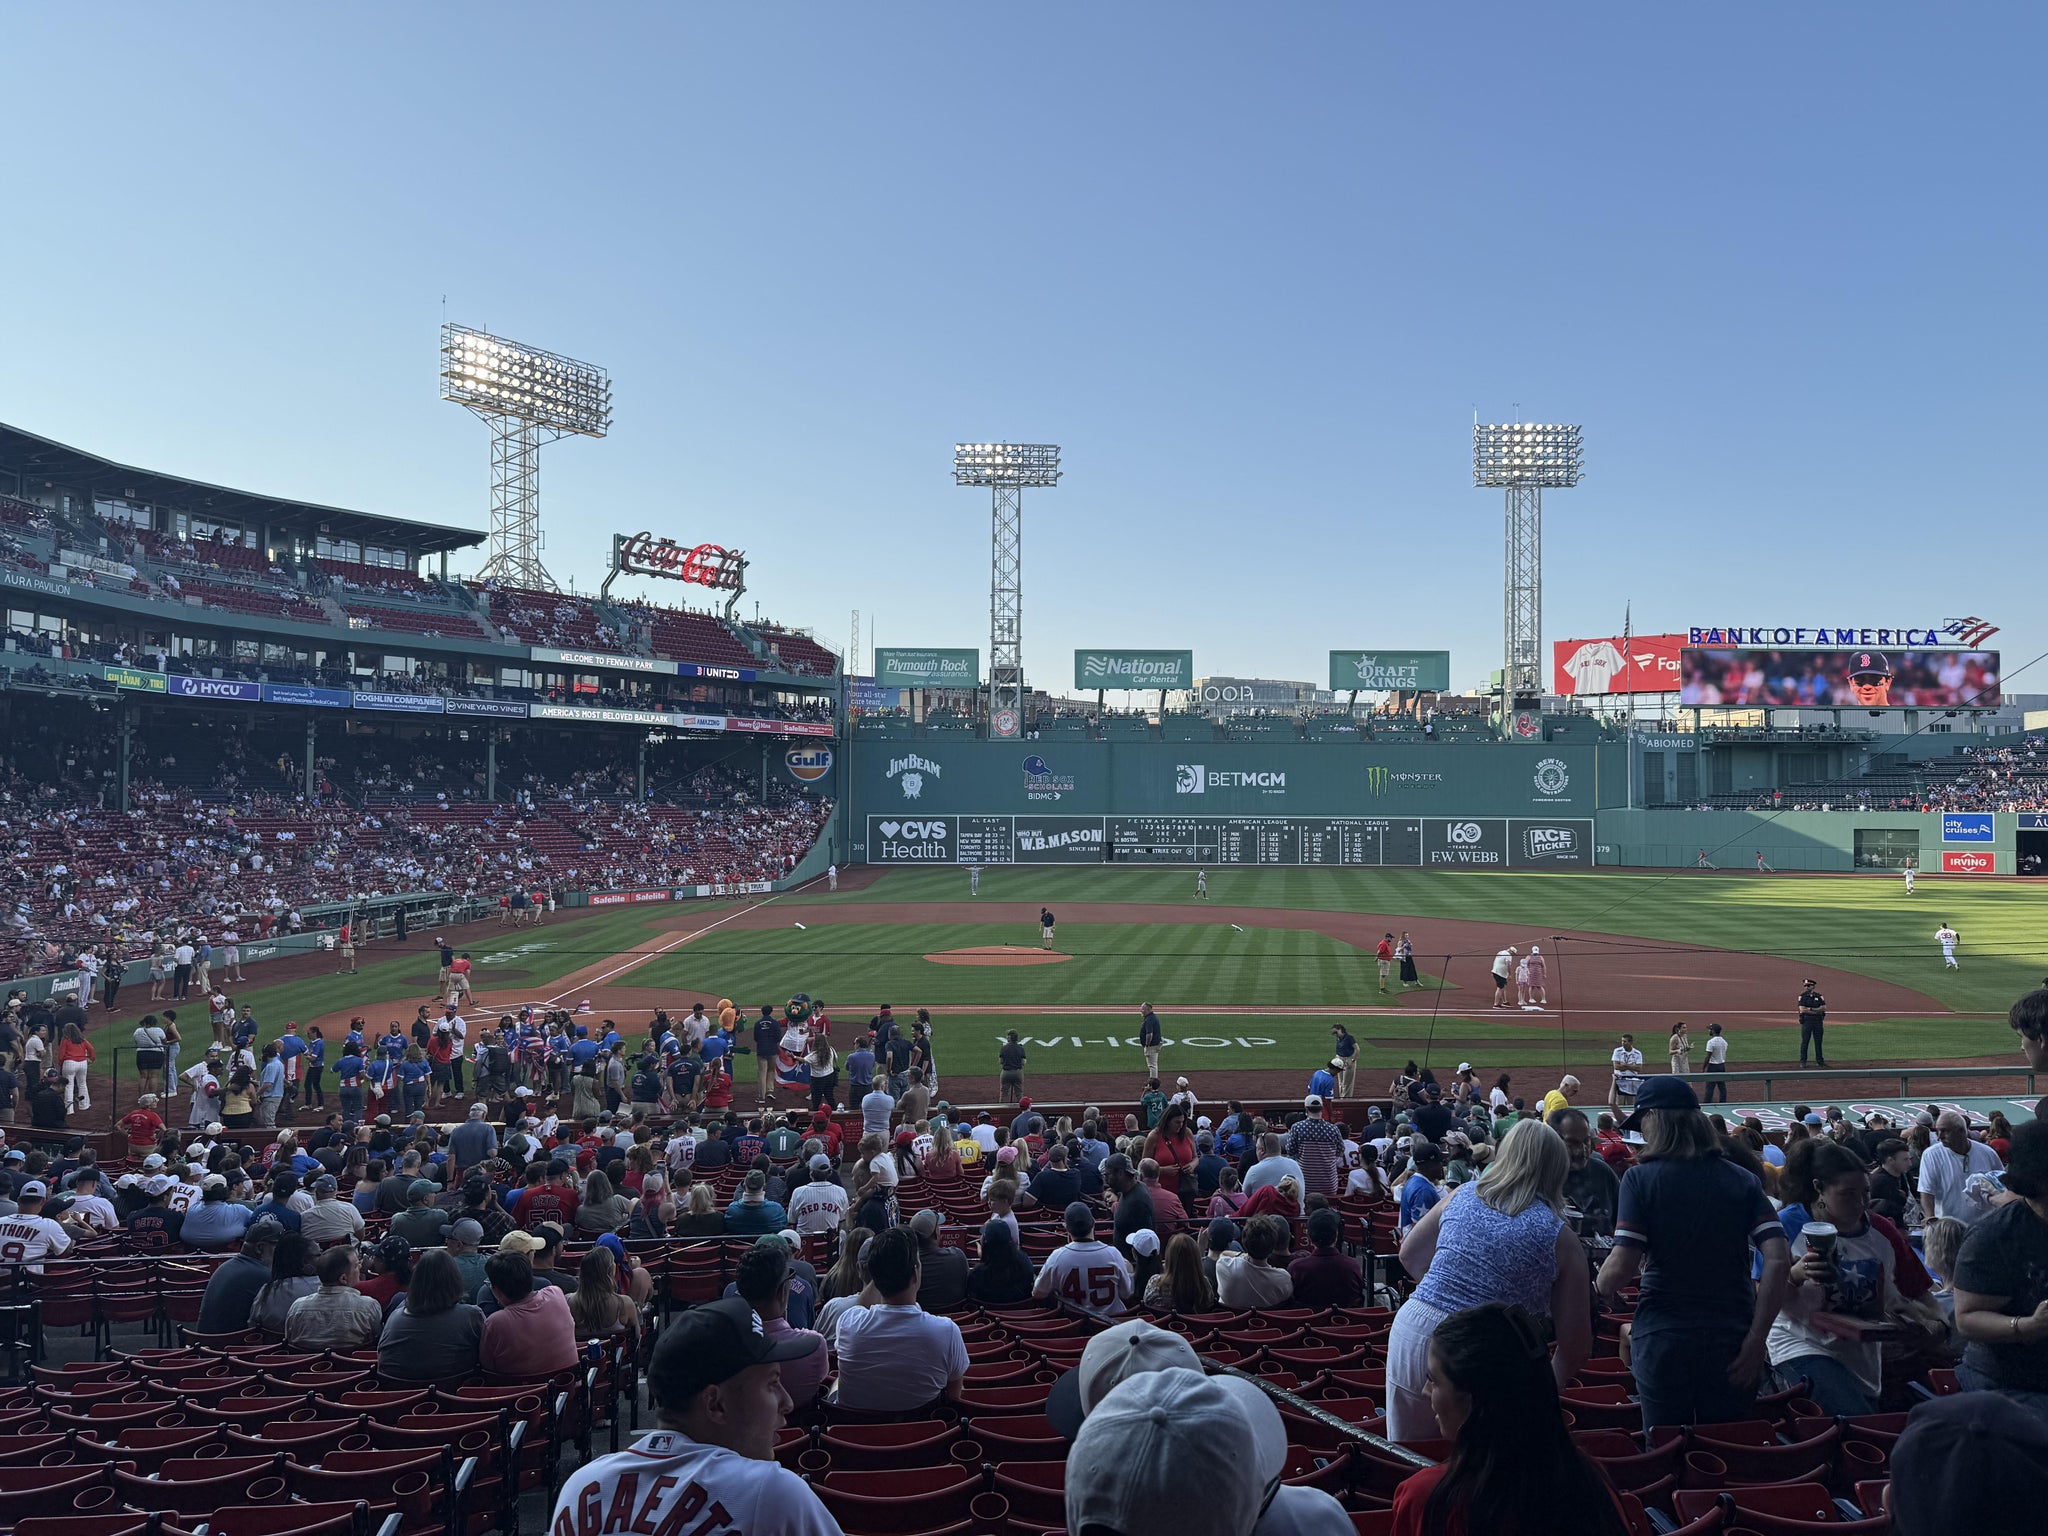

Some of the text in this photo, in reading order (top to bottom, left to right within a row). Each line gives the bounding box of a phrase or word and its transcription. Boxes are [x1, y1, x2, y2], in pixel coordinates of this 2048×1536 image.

[34, 579, 70, 597] PAVILION
[1688, 626, 1940, 647] BANK OF AMERICA
[560, 653, 654, 670] WELCOME TO FENWAY PARK
[887, 659, 968, 674] Plymouth Rock
[1107, 658, 1182, 675] National
[1594, 659, 1608, 669] SOX
[706, 667, 740, 679] UNITED
[1357, 664, 1419, 679] DRAFT
[150, 679, 164, 690] TIRE
[1133, 675, 1178, 684] Car Rental
[1365, 678, 1417, 688] KINGS
[200, 683, 241, 697] HYCU
[356, 694, 393, 704] COGHLIN
[394, 696, 443, 707] COMPANIES
[455, 702, 524, 714] VINEYARD VINES
[542, 708, 668, 723] AMERICA'S MOST BELOVED BALLPARK
[784, 724, 808, 732] Safelite
[1647, 738, 1694, 748] ABIOMED
[787, 752, 830, 768] Gulf
[1053, 775, 1075, 784] SOX
[1208, 772, 1286, 786] BETMGM
[1028, 792, 1053, 801] BIDMC
[902, 821, 947, 840] CVS
[1031, 830, 1043, 838] BUT
[1447, 822, 1482, 844] 160
[1534, 829, 1572, 844] ACE
[853, 843, 865, 851] 310
[881, 840, 947, 859] Health
[1534, 842, 1572, 853] TICKET
[1596, 845, 1611, 853] 379
[1431, 852, 1499, 864] F.W. WEBB
[1950, 858, 1988, 867] IRVING
[750, 883, 765, 891] TRULY
[593, 894, 625, 905] Safelite
[635, 892, 666, 903] Safelite
[1151, 1102, 1164, 1113] 24
[679, 1148, 694, 1162] 16
[959, 1146, 974, 1157] 10
[801, 1203, 839, 1217] RED SOX
[1062, 1266, 1117, 1306] 45
